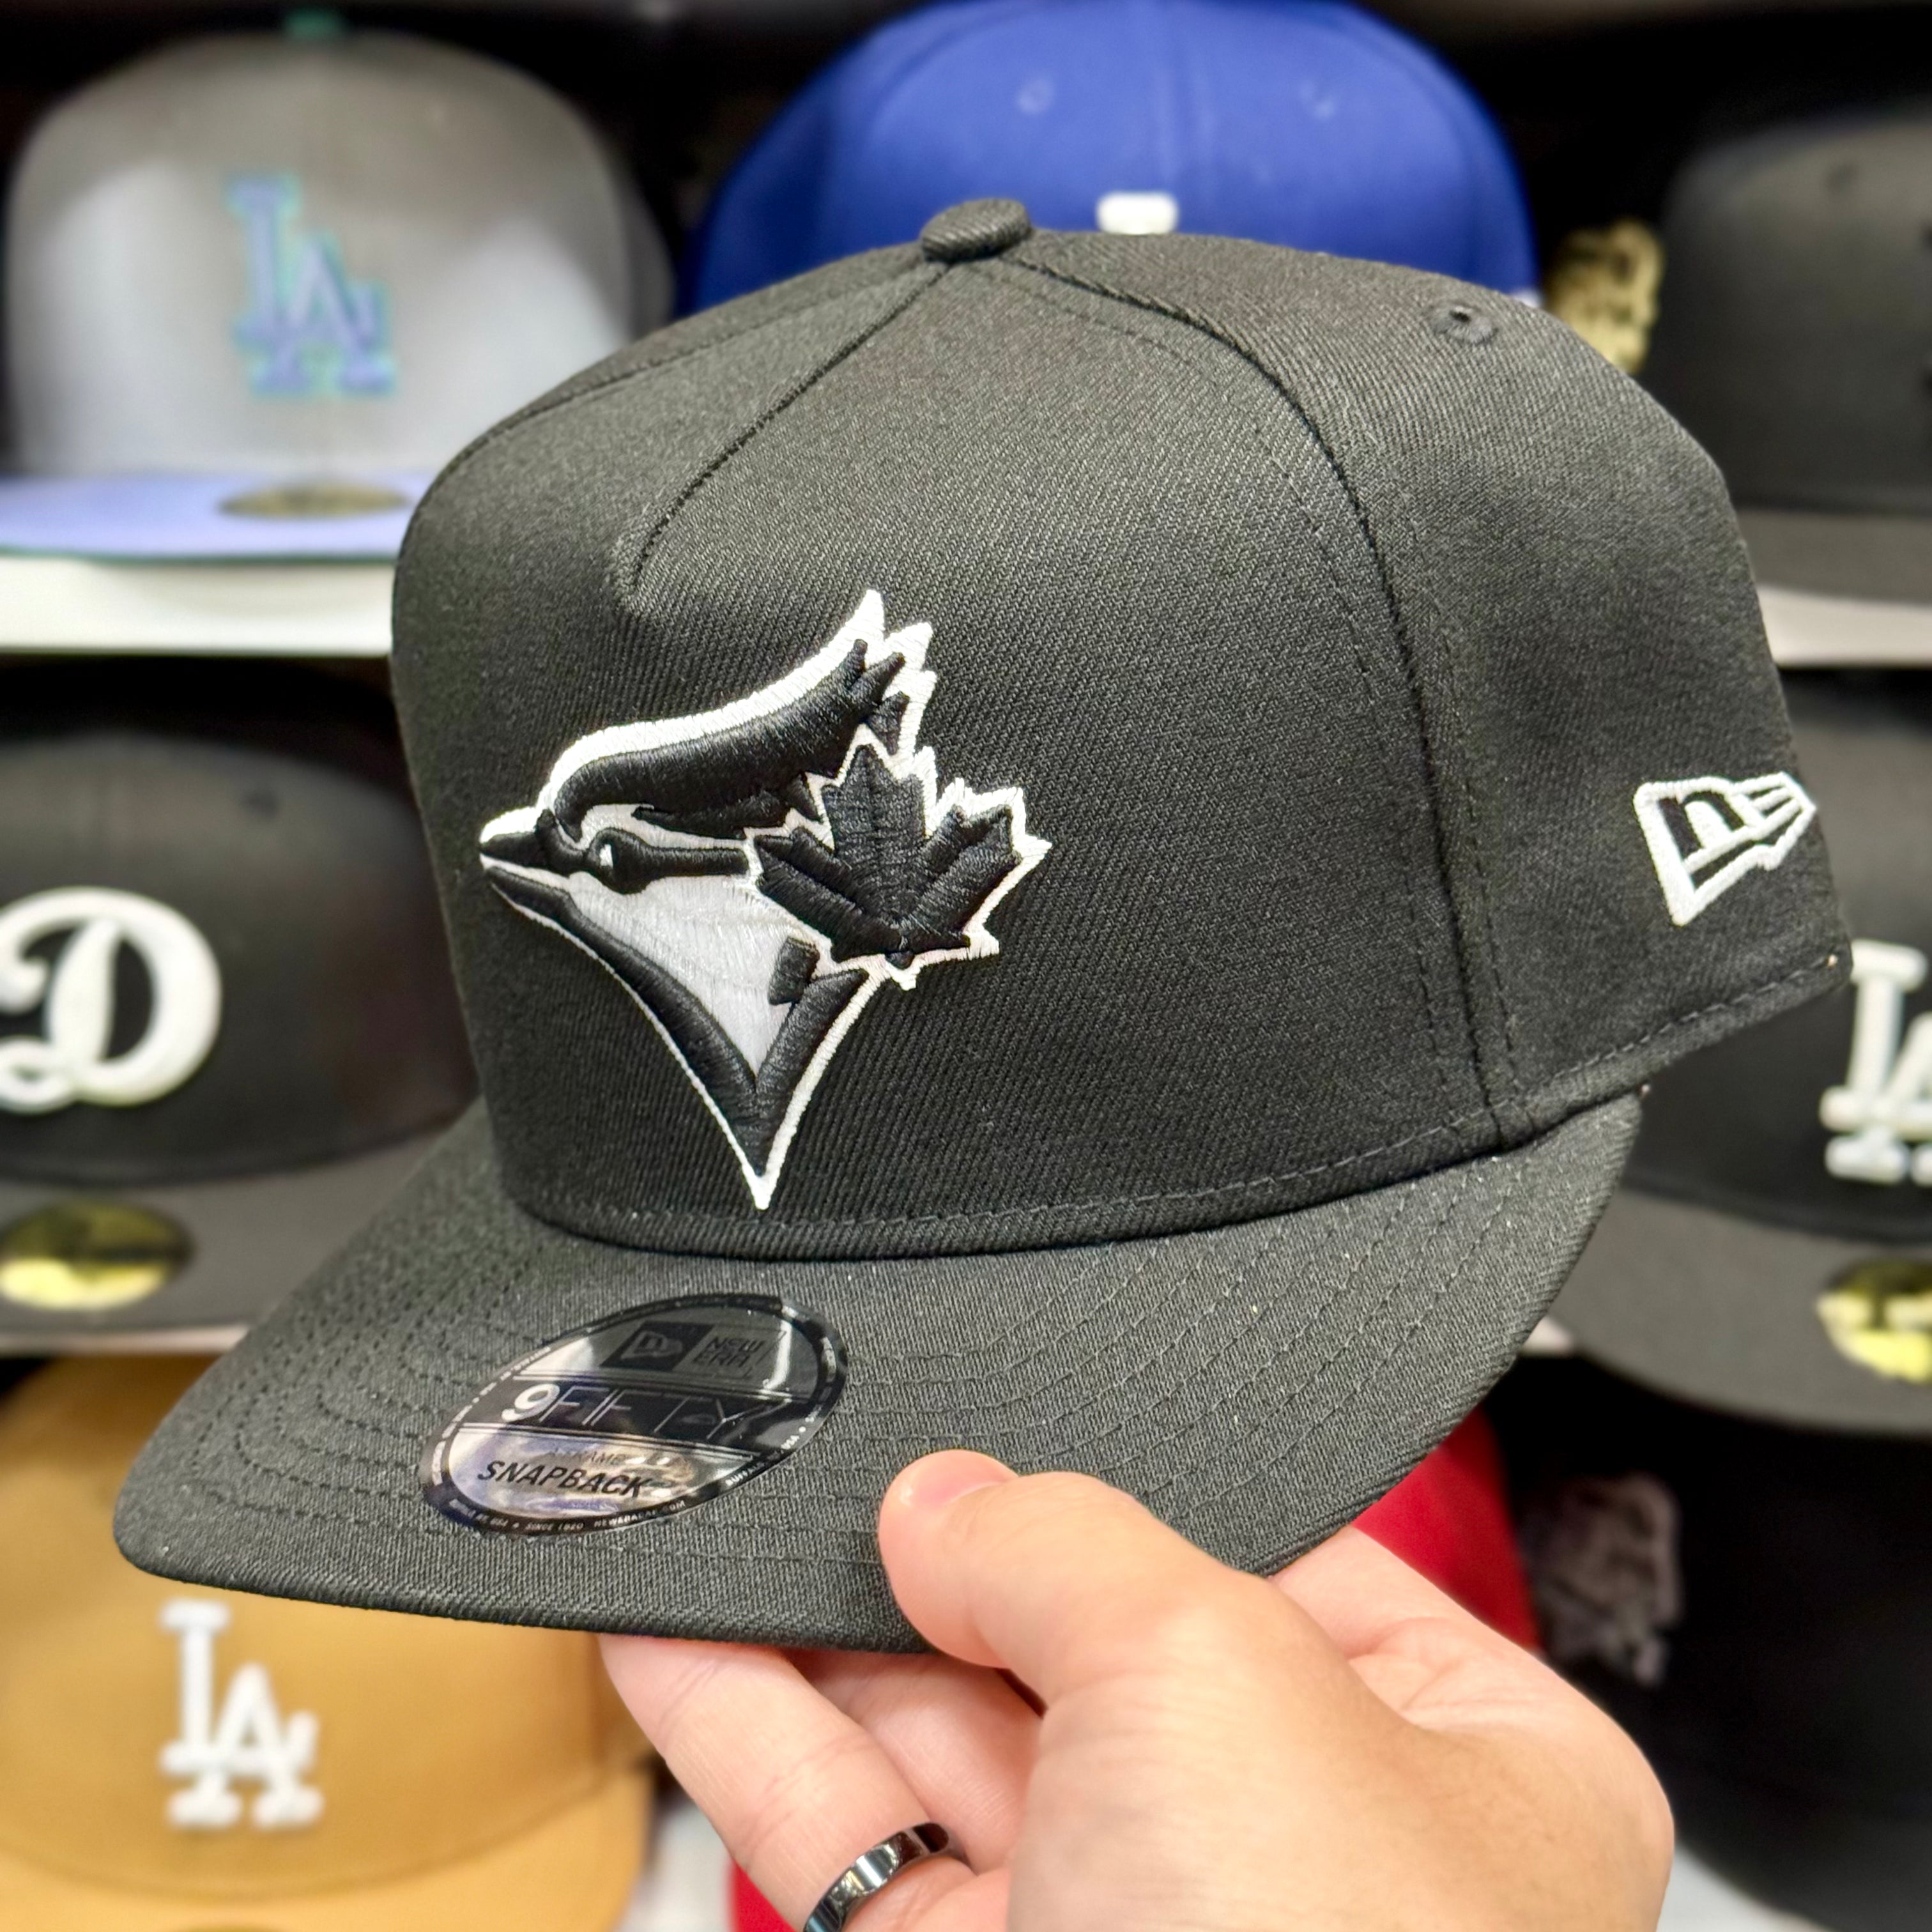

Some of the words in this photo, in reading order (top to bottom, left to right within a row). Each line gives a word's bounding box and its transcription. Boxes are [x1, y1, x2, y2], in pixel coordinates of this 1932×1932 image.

[228, 177, 396, 402] LA
[0, 886, 222, 1114] D
[477, 1460, 653, 1498] SNAPBACK
[160, 1597, 325, 1829] LA
